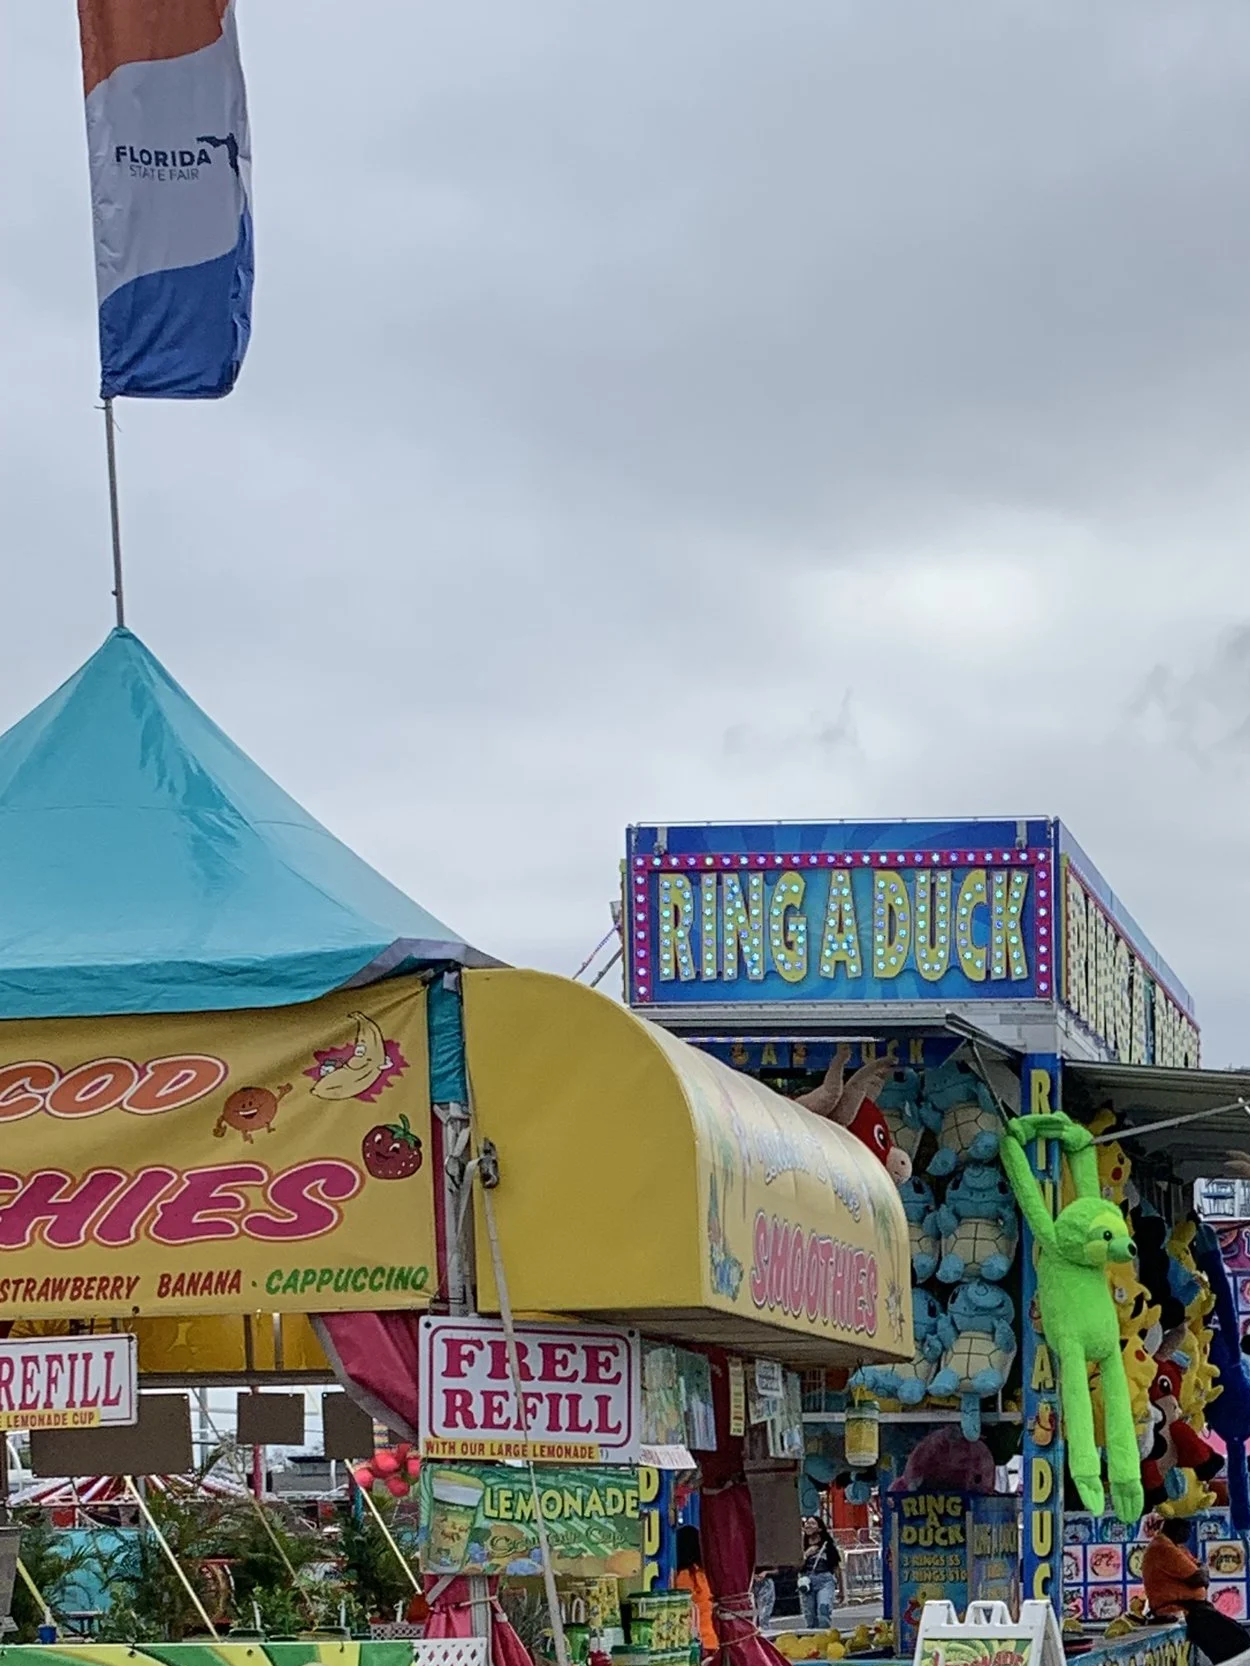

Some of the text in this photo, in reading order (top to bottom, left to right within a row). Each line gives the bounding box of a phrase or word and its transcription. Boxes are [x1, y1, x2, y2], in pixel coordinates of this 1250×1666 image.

[115, 145, 211, 167] FLORIDA
[129, 165, 200, 181] STATE FAIR
[659, 868, 1030, 984] RING A DUCK
[838, 1037, 925, 1065] UCK
[0, 1158, 366, 1250] HIES
[0, 1265, 429, 1302] STRAWBERRY BANANA CAPPUCCINO
[751, 1209, 878, 1336] SMOOTHIES
[441, 1337, 623, 1385] FREE
[1032, 1344, 1055, 1390] A
[0, 1351, 122, 1411] REFILL
[6, 1411, 95, 1429] LEMONADE CUP
[441, 1389, 623, 1435] REFILL
[425, 1441, 456, 1455] WITH
[461, 1441, 485, 1456] OUR
[490, 1442, 528, 1457] LARGE
[532, 1443, 595, 1459] LEMONADE
[483, 1486, 640, 1522] LEMONADE
[901, 1495, 963, 1518] RING
[926, 1512, 940, 1528] A
[900, 1524, 966, 1547] DUCK
[1032, 1457, 1053, 1600] DUC
